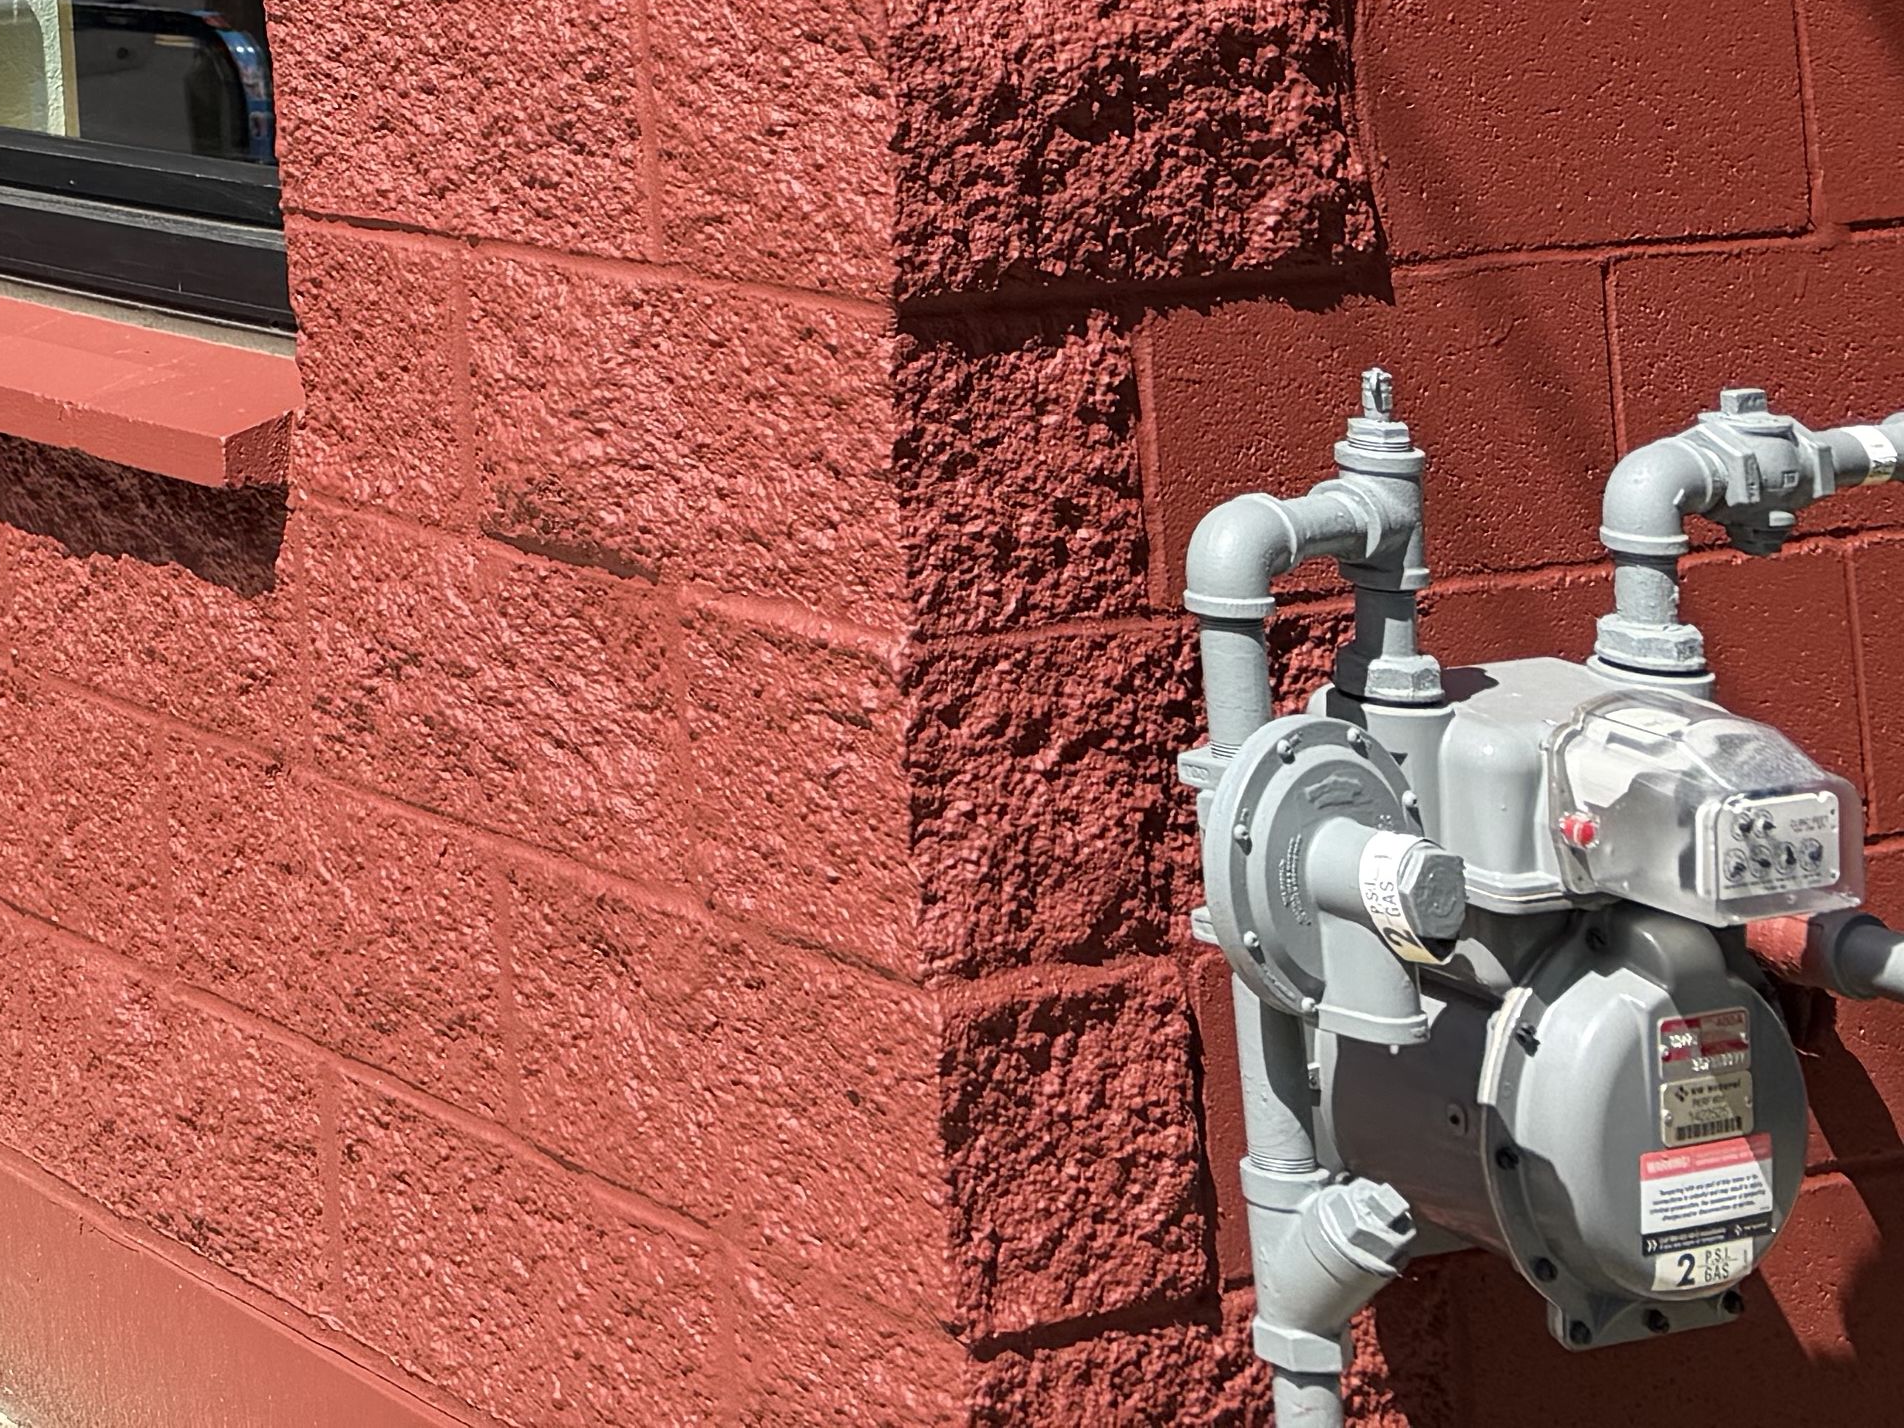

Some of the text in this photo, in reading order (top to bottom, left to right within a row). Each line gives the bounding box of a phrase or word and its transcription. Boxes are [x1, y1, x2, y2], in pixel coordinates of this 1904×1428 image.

[1380, 881, 1401, 917] GAS
[1383, 927, 1423, 949] 2
[1677, 1253, 1695, 1287] 2
[1704, 1263, 1729, 1282] GAS
